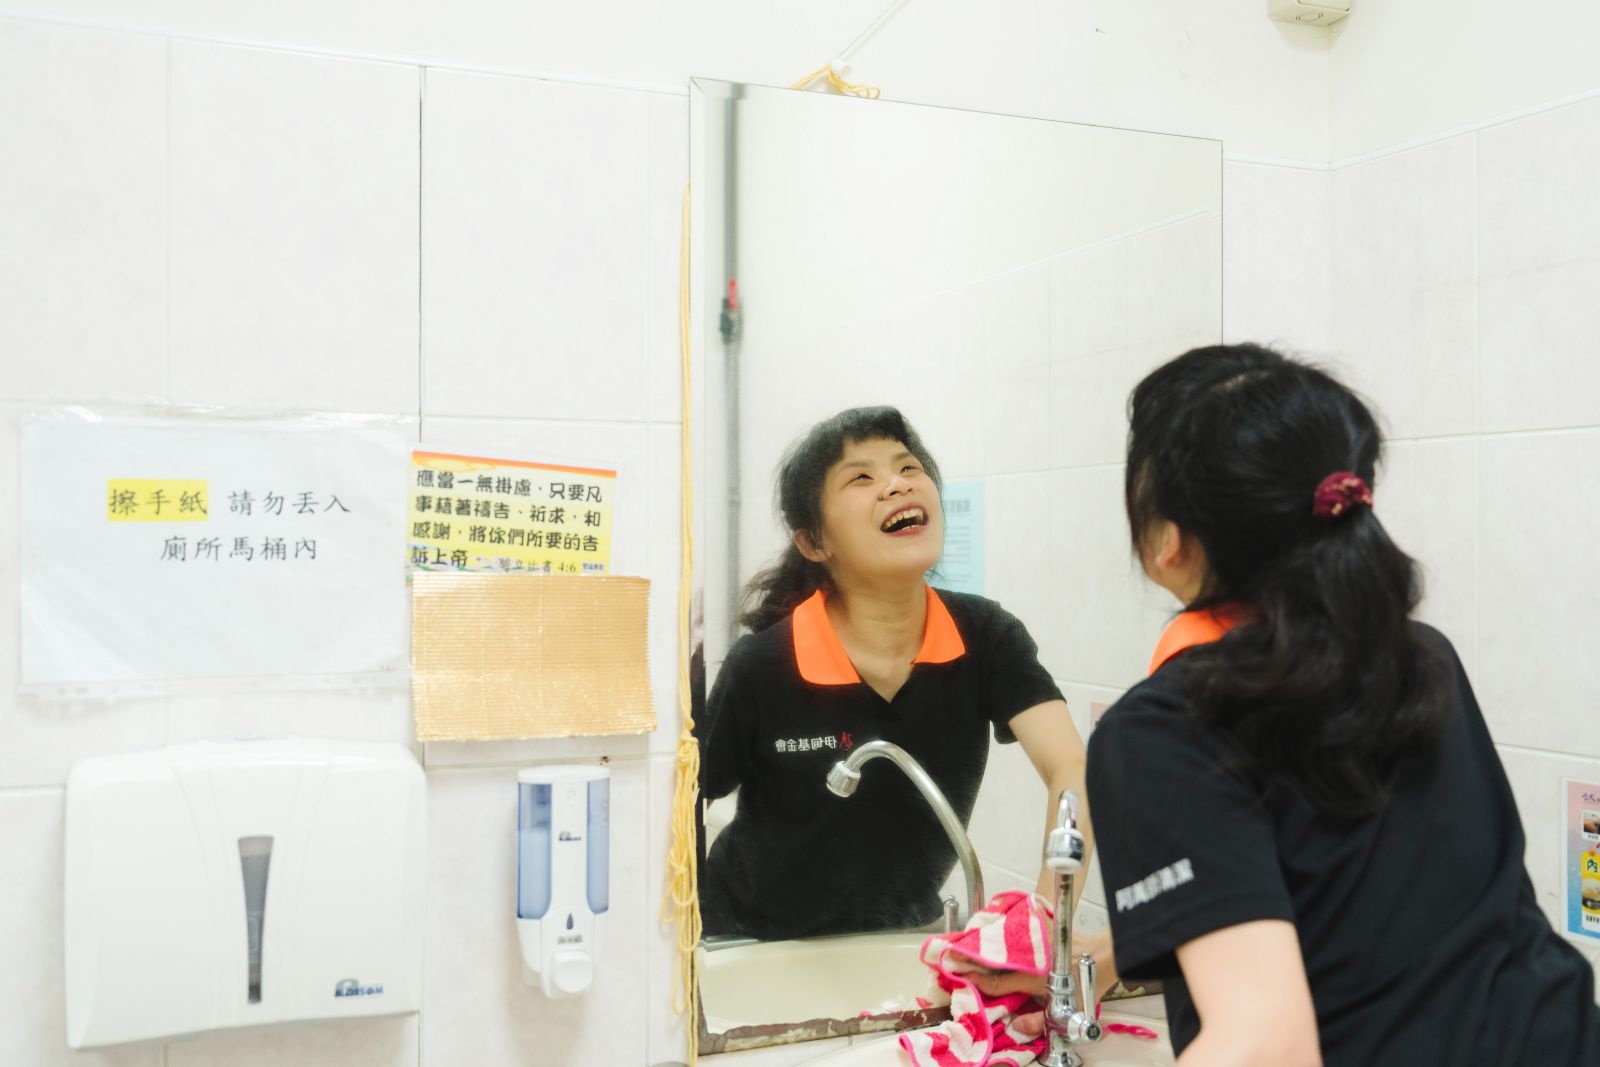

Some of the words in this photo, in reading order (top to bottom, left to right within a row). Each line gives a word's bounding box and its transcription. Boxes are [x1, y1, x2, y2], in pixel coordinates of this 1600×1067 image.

[108, 489, 209, 516] 擦手紙
[228, 490, 352, 516] 請勿丟入
[161, 535, 318, 562] 廁所馬桶內
[556, 562, 576, 574] 4:6
